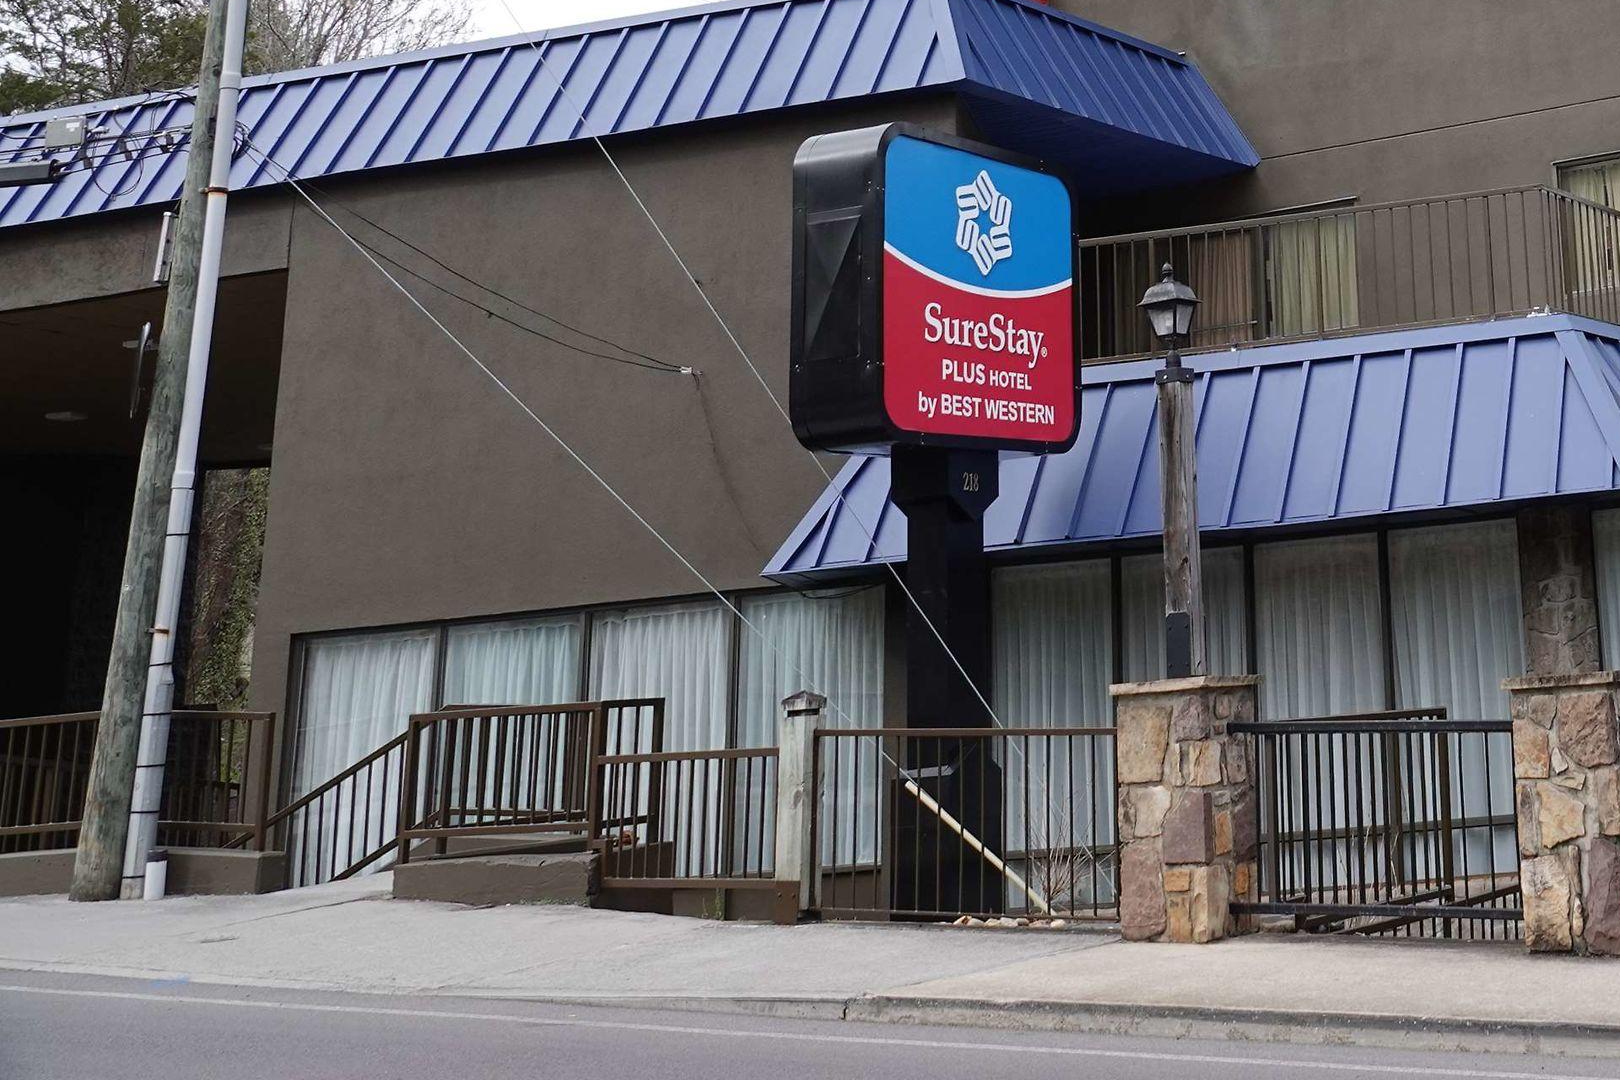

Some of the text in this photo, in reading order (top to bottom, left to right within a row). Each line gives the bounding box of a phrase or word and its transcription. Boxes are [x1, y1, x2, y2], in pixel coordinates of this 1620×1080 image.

[924, 302, 1044, 369] SureStay
[942, 358, 1032, 391] PLUS HOTEL
[918, 390, 1055, 425] by BEST WESTERN
[962, 471, 979, 492] 218
